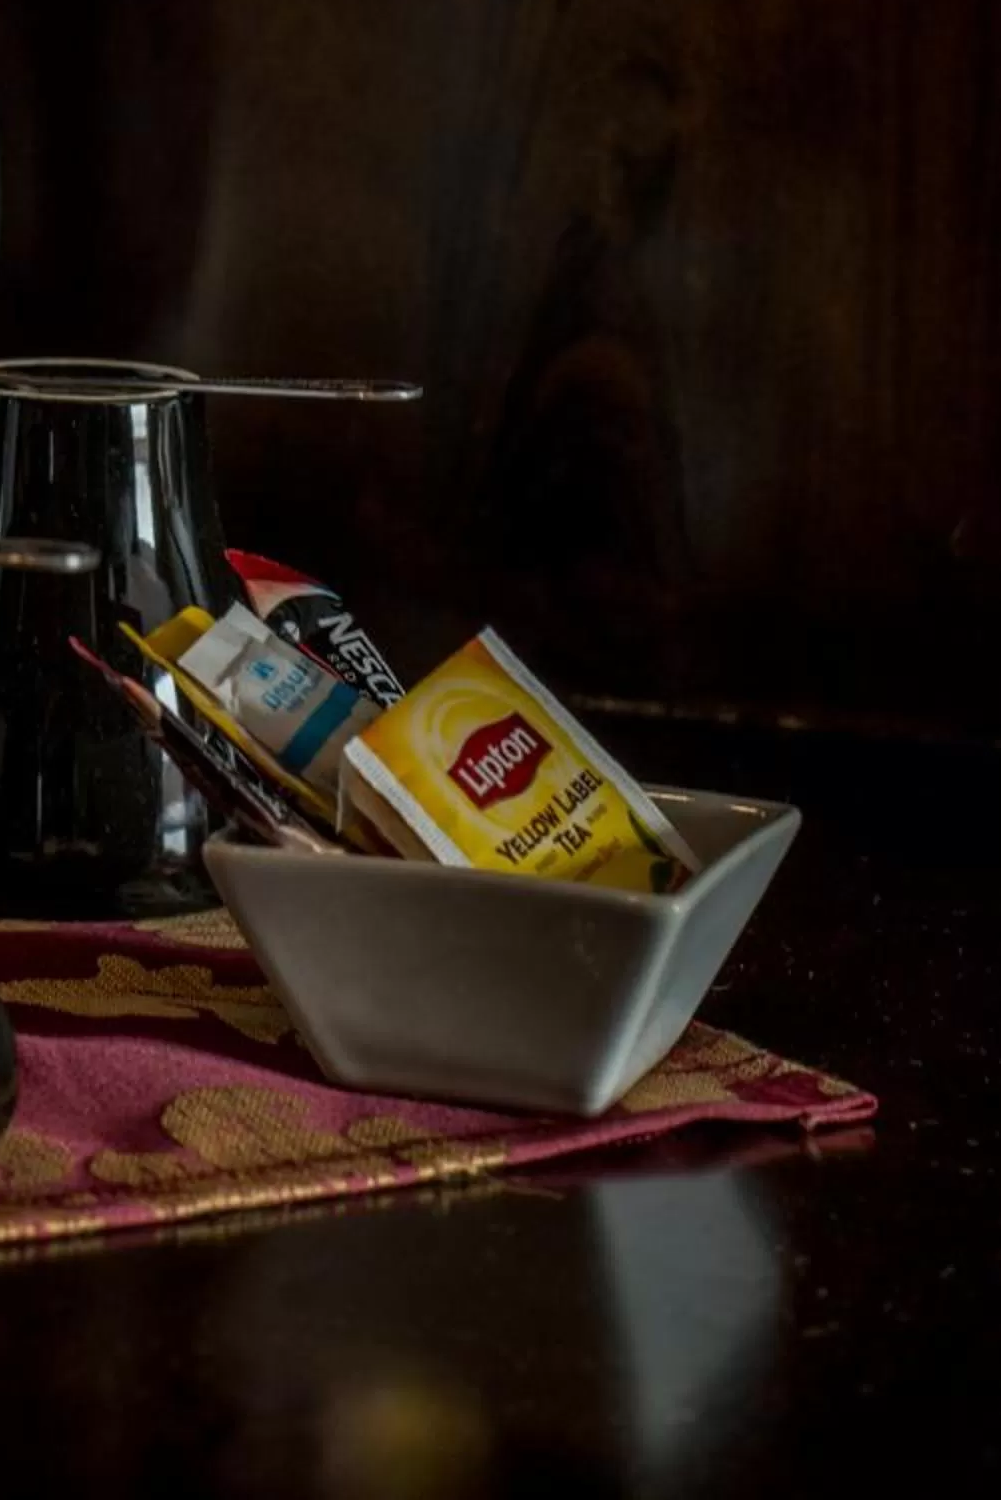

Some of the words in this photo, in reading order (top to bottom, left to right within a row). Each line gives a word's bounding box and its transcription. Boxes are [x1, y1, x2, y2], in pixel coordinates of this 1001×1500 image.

[457, 725, 539, 797] Lipton
[496, 803, 561, 864] YELLOW
[551, 769, 603, 815] LABEL
[553, 822, 594, 856] TEA
